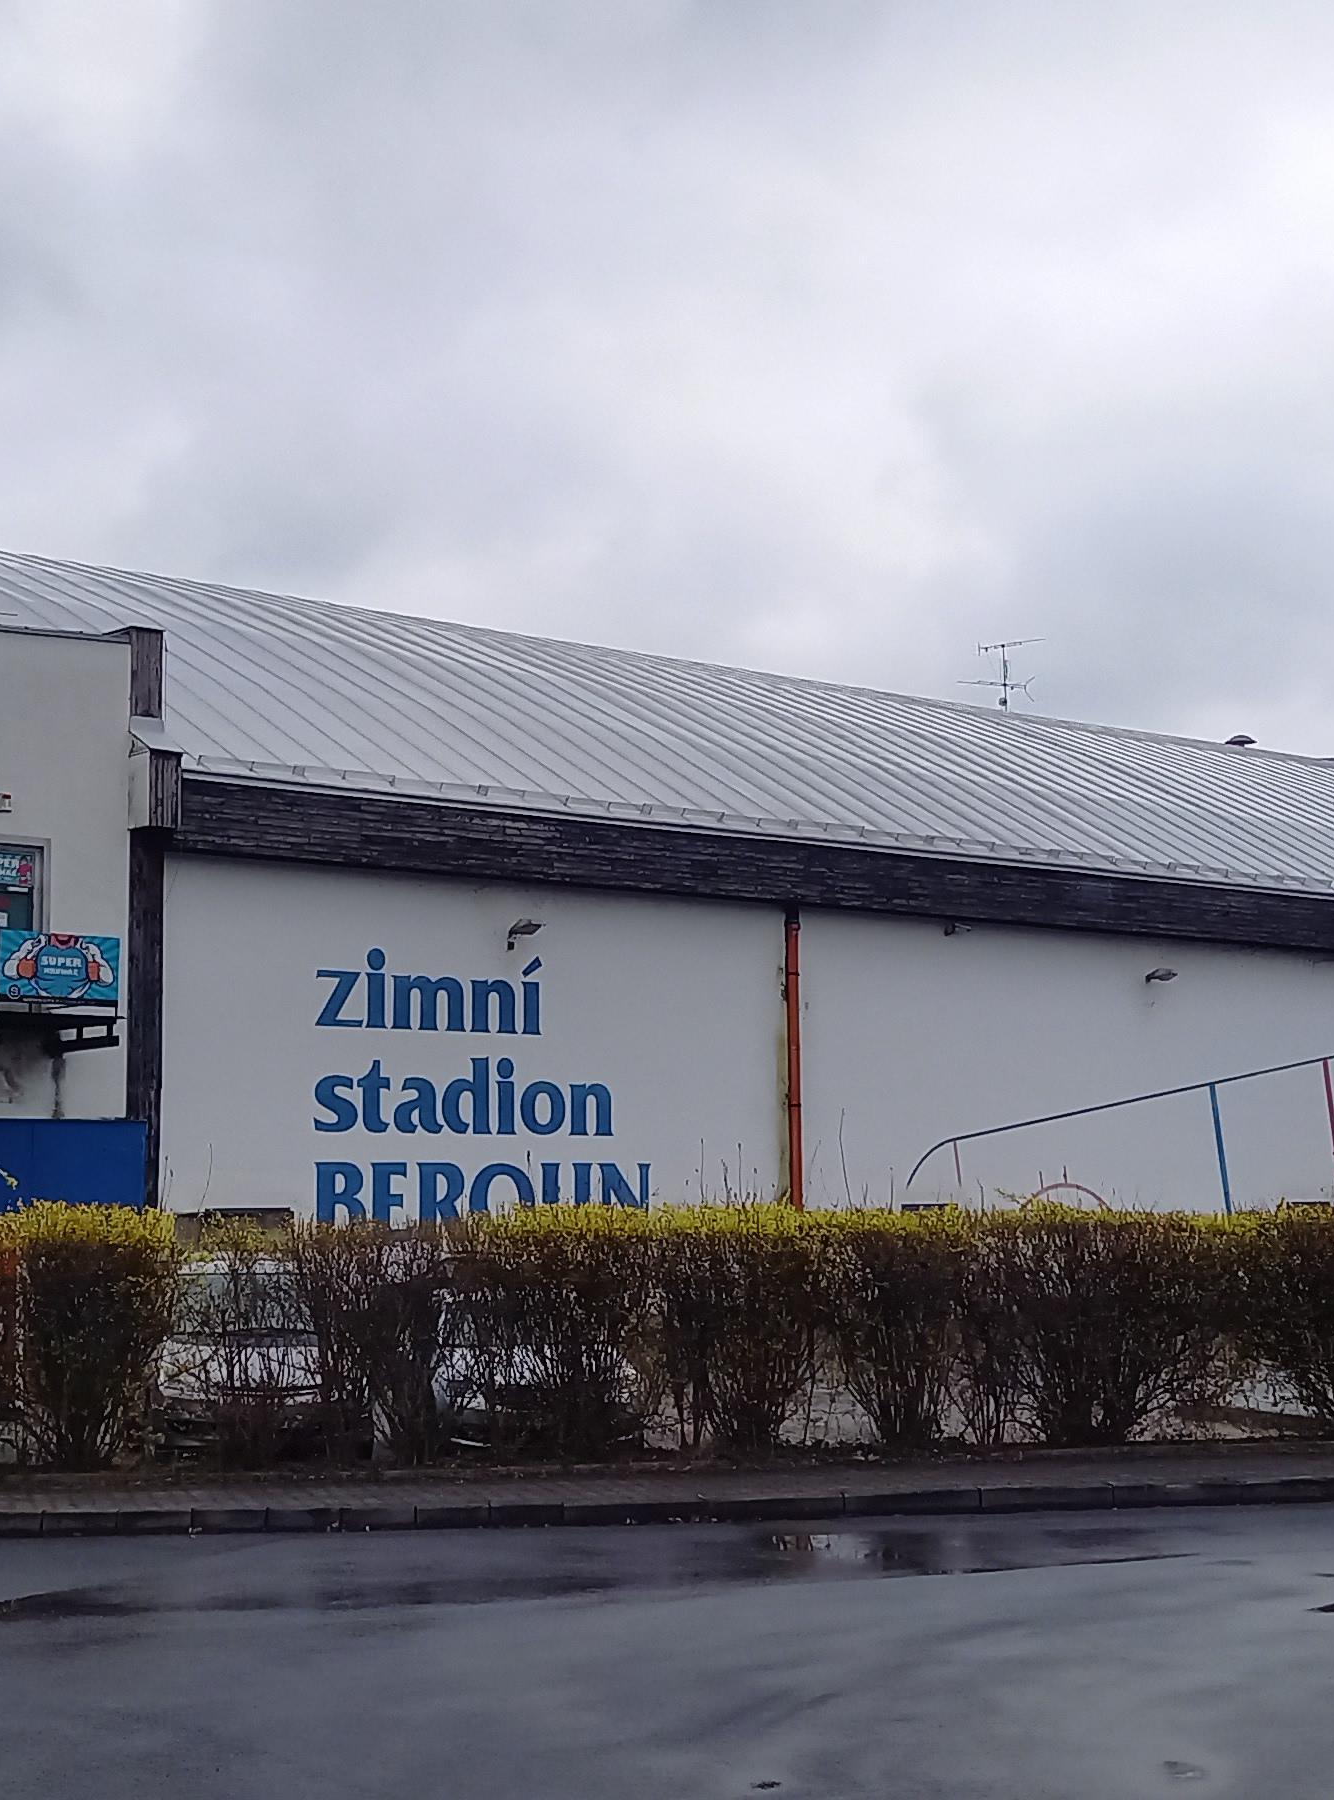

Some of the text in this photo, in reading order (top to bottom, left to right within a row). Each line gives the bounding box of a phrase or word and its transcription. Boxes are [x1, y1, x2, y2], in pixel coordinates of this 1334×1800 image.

[40, 955, 83, 968] SUPER
[315, 947, 543, 1036] zimní
[313, 1056, 615, 1137] stadion
